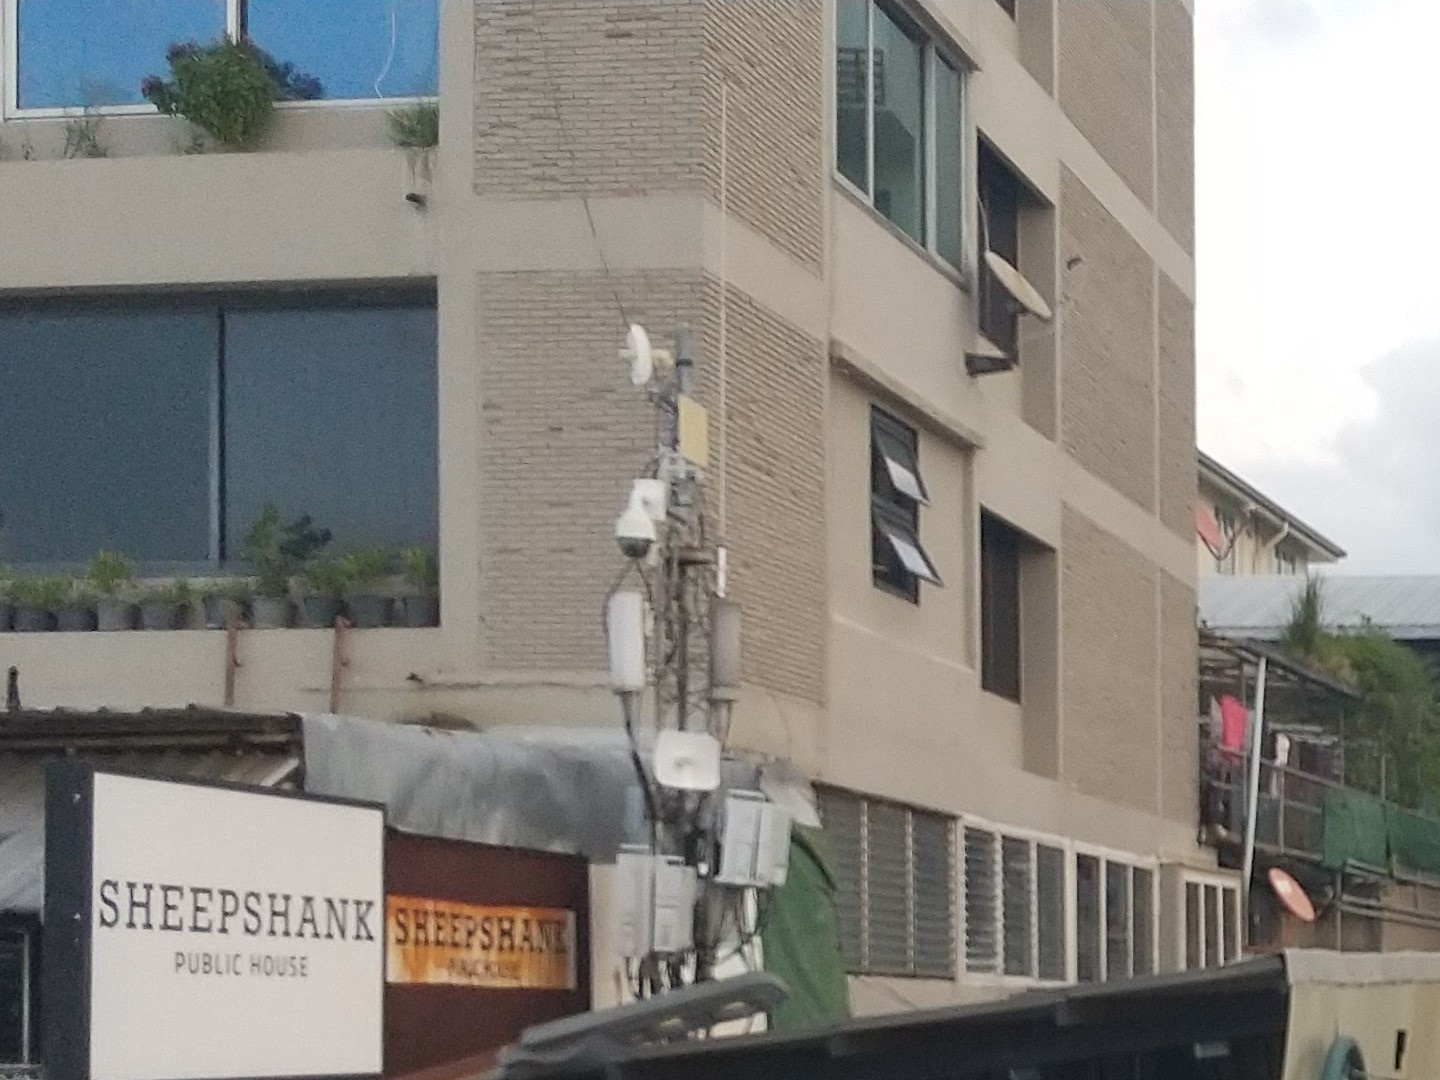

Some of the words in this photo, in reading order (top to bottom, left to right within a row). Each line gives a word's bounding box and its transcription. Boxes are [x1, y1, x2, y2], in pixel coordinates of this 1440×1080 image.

[99, 878, 375, 942] SHEEPSHANK
[173, 950, 243, 977] PUBLIC
[249, 954, 309, 978] HOUSE
